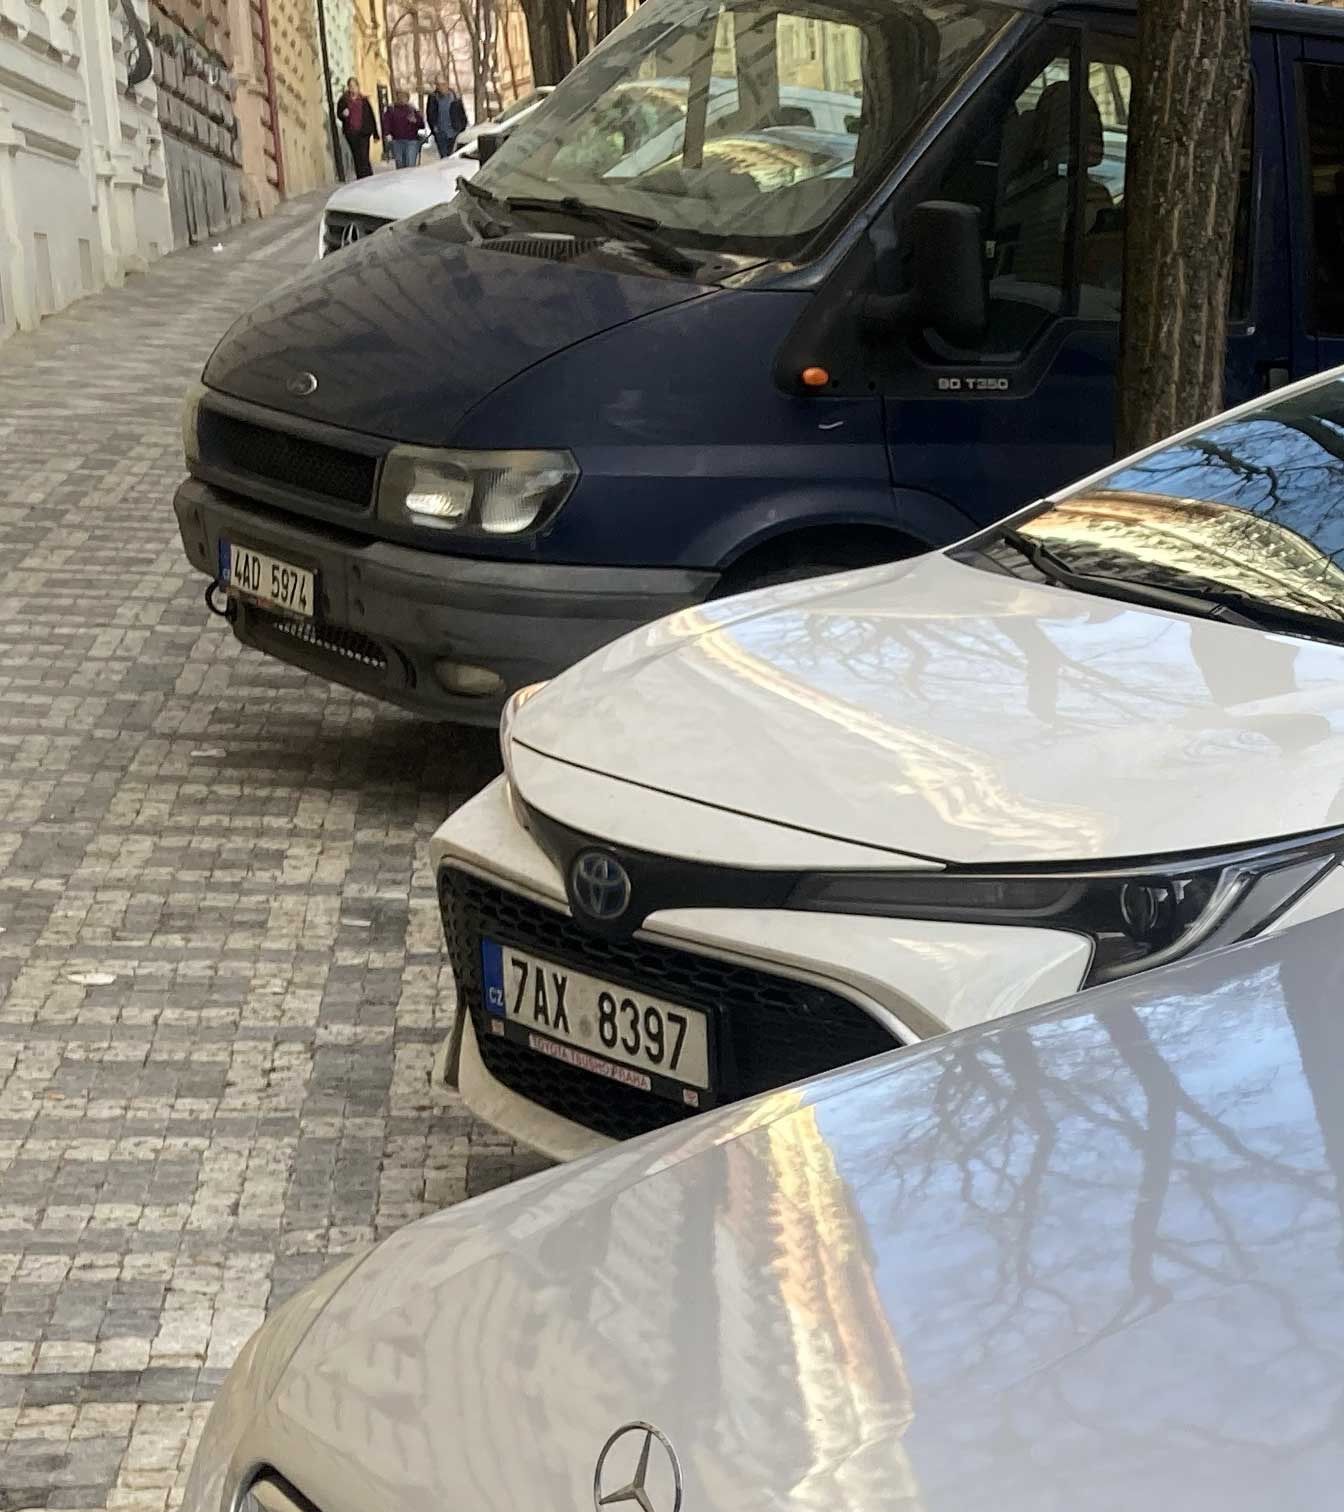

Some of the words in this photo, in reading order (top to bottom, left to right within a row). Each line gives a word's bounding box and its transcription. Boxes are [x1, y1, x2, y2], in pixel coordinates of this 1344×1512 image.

[234, 549, 261, 591] 4AD
[271, 564, 307, 610] 5974
[489, 986, 504, 1007] CZ
[511, 957, 570, 1034] 7AX
[598, 991, 688, 1071] 8397
